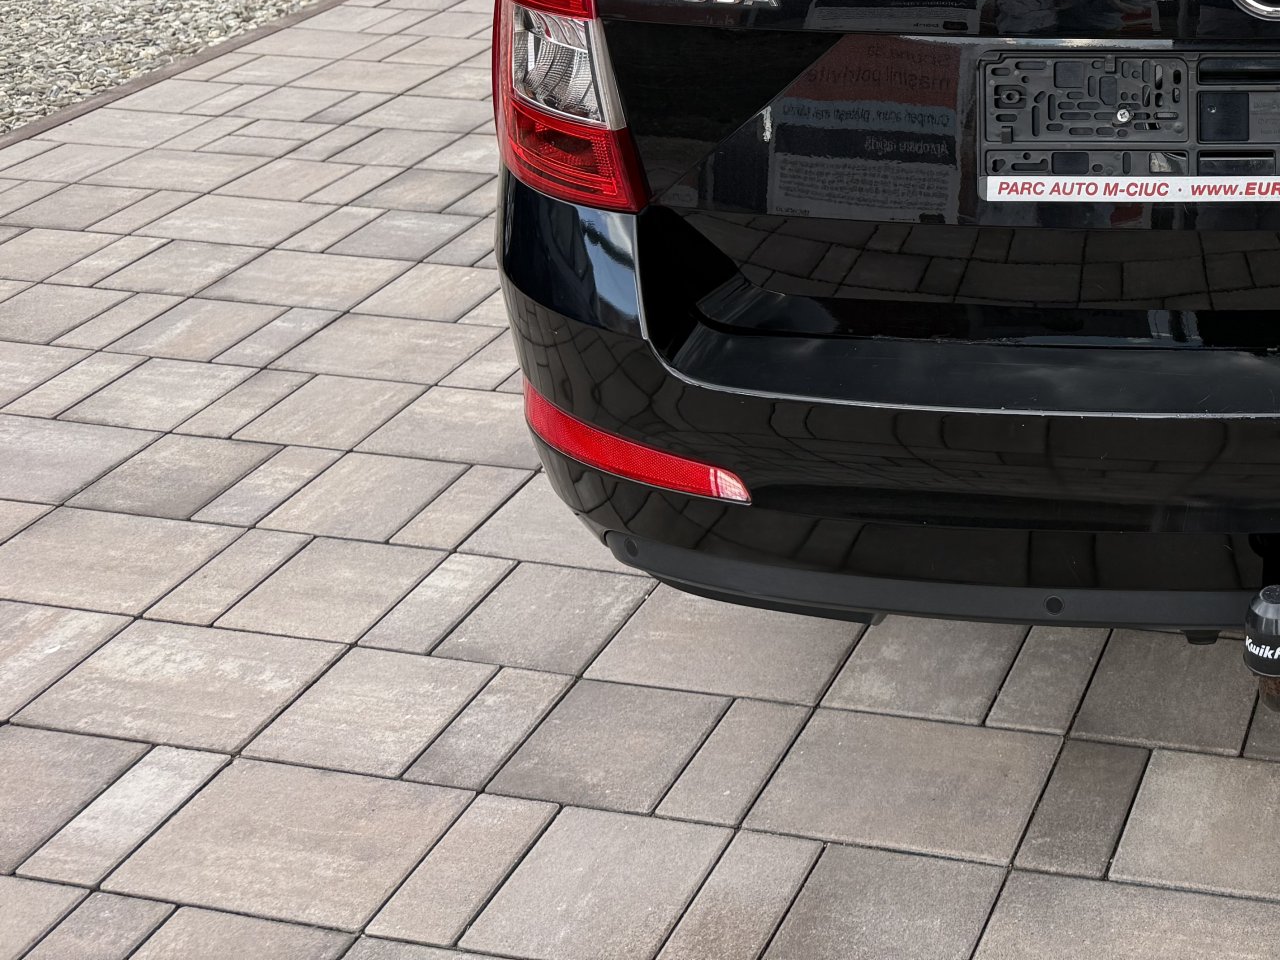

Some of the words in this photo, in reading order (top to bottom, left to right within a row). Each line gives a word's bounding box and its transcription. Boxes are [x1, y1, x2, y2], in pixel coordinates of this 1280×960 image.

[997, 181, 1046, 196] PARC
[1049, 181, 1098, 196] AUTO
[1102, 181, 1170, 197] M-CIUC
